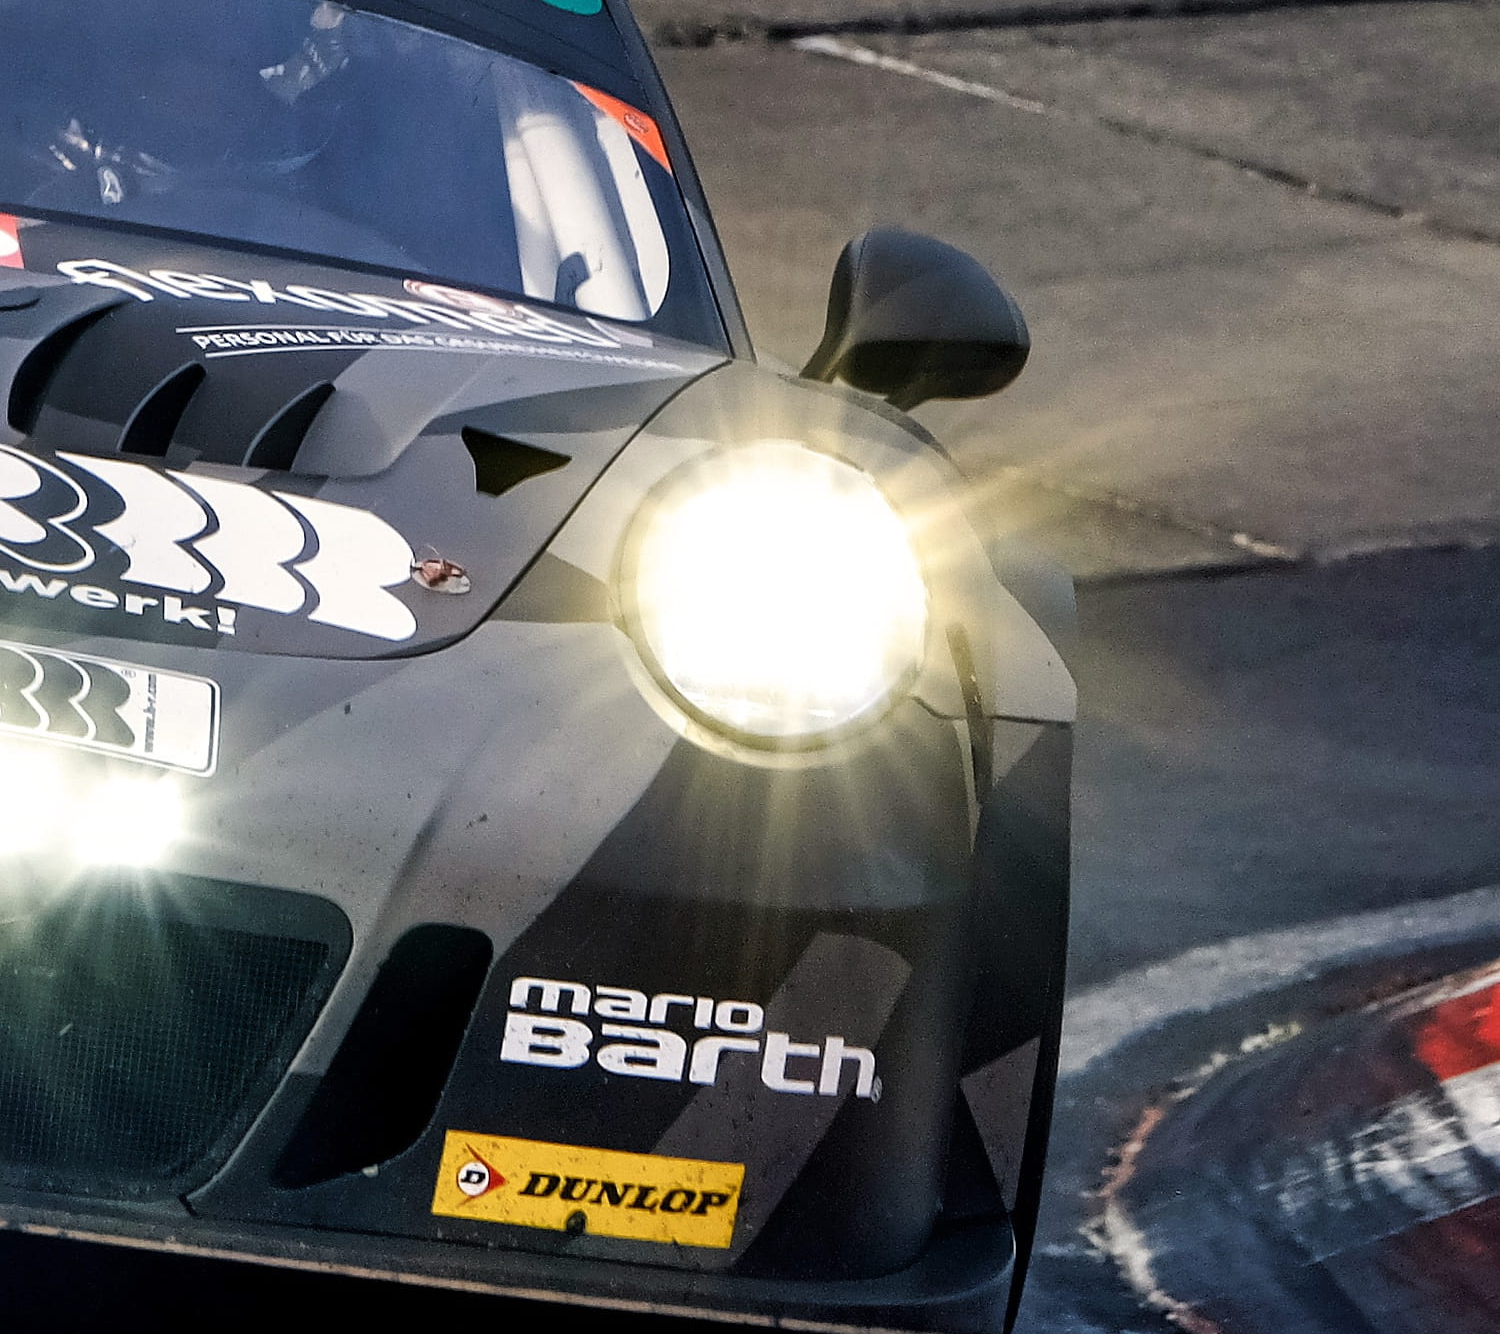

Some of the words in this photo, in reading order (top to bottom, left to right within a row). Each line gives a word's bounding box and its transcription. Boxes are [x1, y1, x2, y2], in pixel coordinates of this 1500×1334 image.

[192, 330, 328, 350] PERSONAL
[509, 975, 764, 1034] mario
[499, 1011, 878, 1100] Barth
[518, 1172, 732, 1216] DUNLOP
